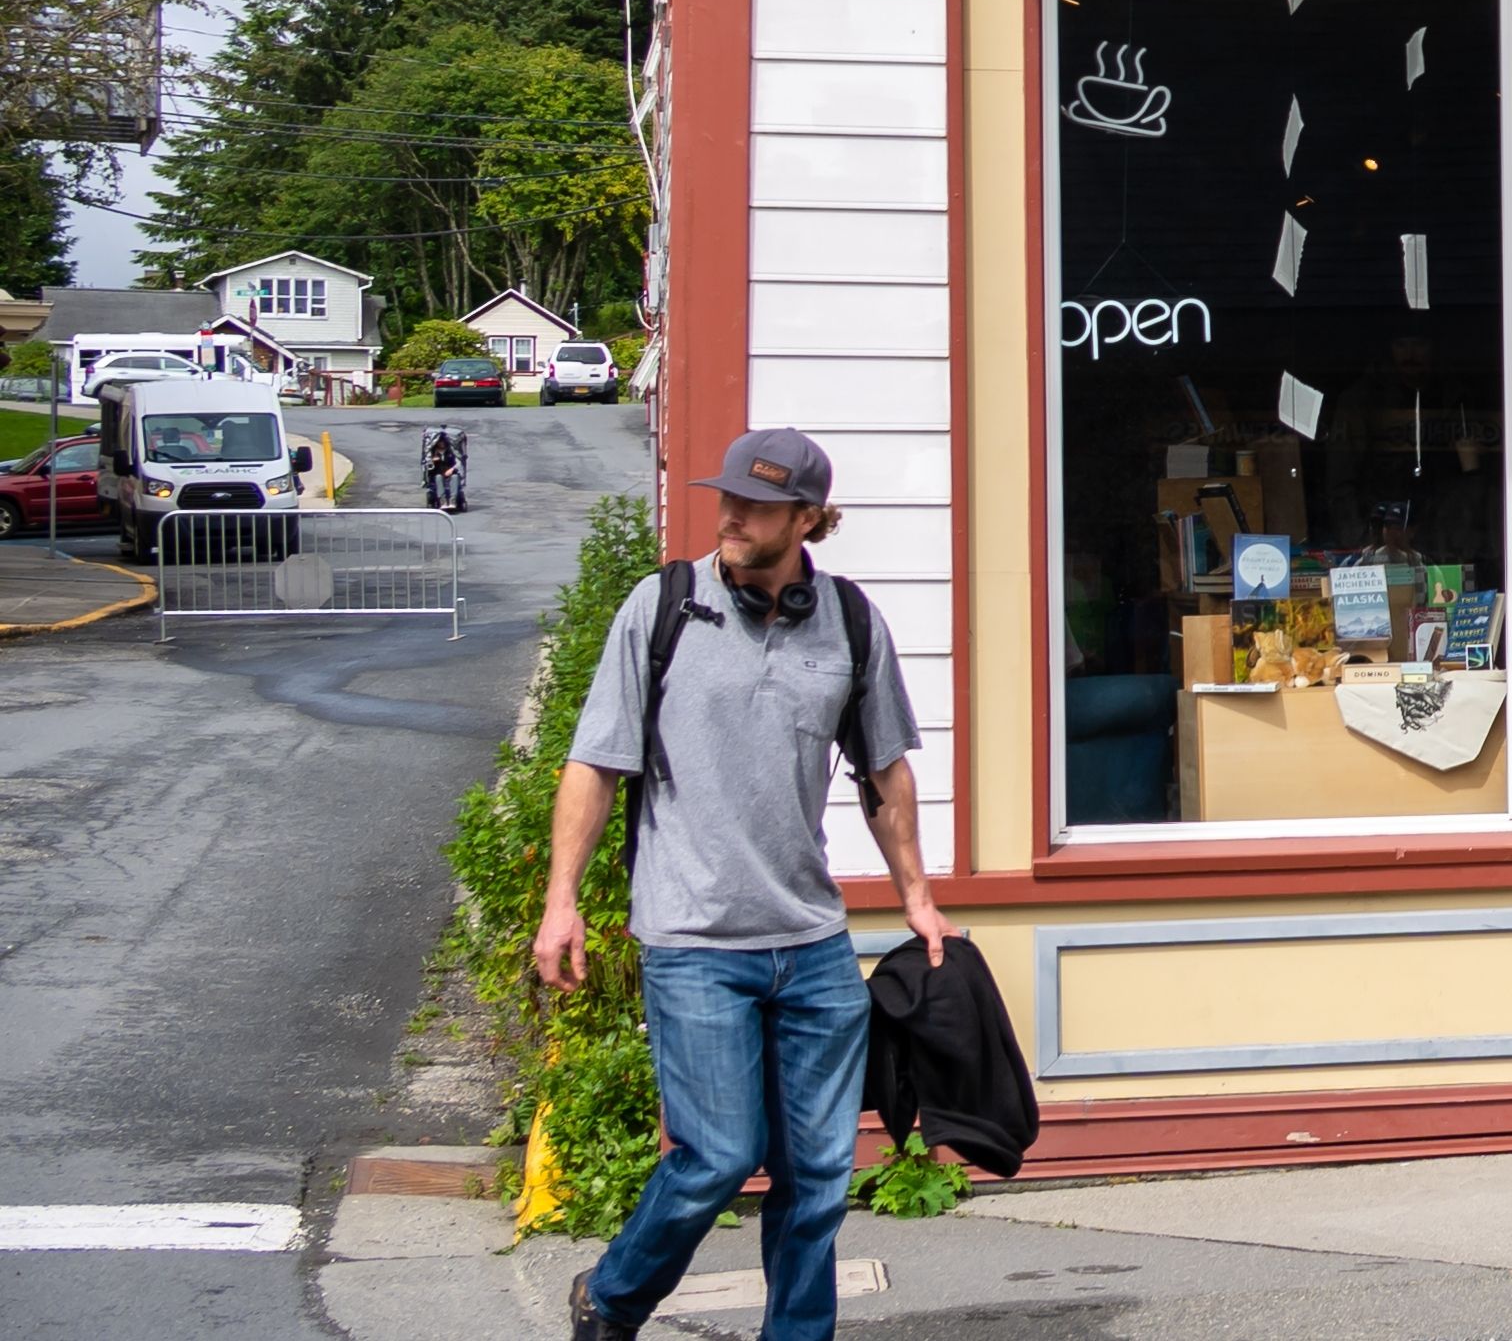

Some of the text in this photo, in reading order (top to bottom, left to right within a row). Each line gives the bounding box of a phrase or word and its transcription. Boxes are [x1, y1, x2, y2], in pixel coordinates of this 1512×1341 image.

[1061, 298, 1211, 360] open
[1337, 571, 1367, 580] JAMES
[1334, 580, 1383, 589] MICHENER
[1337, 594, 1384, 606] ALASKA
